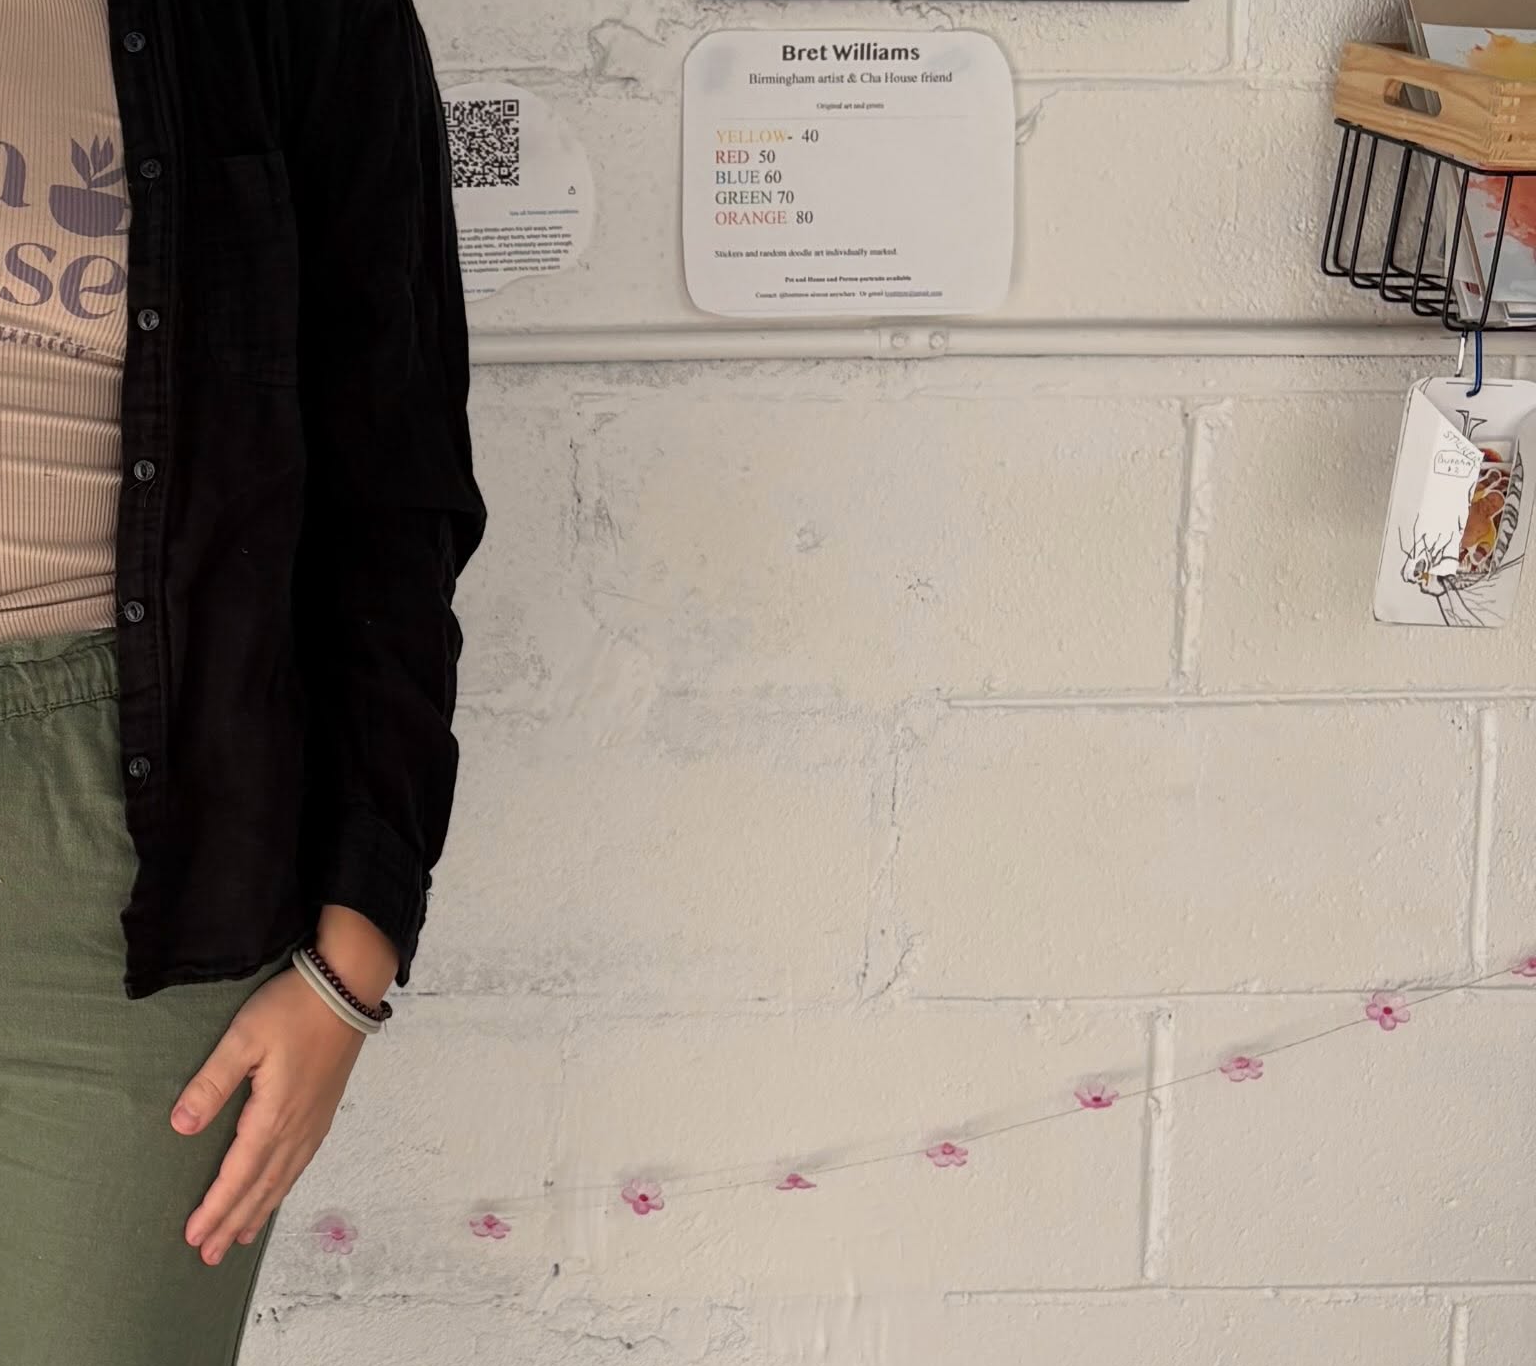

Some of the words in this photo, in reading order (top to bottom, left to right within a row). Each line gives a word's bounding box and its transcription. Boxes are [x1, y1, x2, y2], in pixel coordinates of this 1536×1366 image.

[782, 44, 828, 61] Bret
[832, 42, 921, 61] Williams
[749, 73, 815, 87] Birmingham
[817, 72, 844, 84] artist
[846, 73, 857, 84] &
[860, 72, 882, 83] Cha
[884, 72, 918, 83] House
[921, 71, 953, 83] friend
[801, 129, 819, 143] 40
[715, 149, 750, 164] RED
[758, 149, 776, 164] 50
[715, 170, 760, 185] BLUE
[764, 169, 782, 184] 60
[715, 190, 772, 205] GREEN
[777, 190, 795, 204] 70
[715, 210, 787, 226] ORANGE
[795, 210, 814, 225] 80
